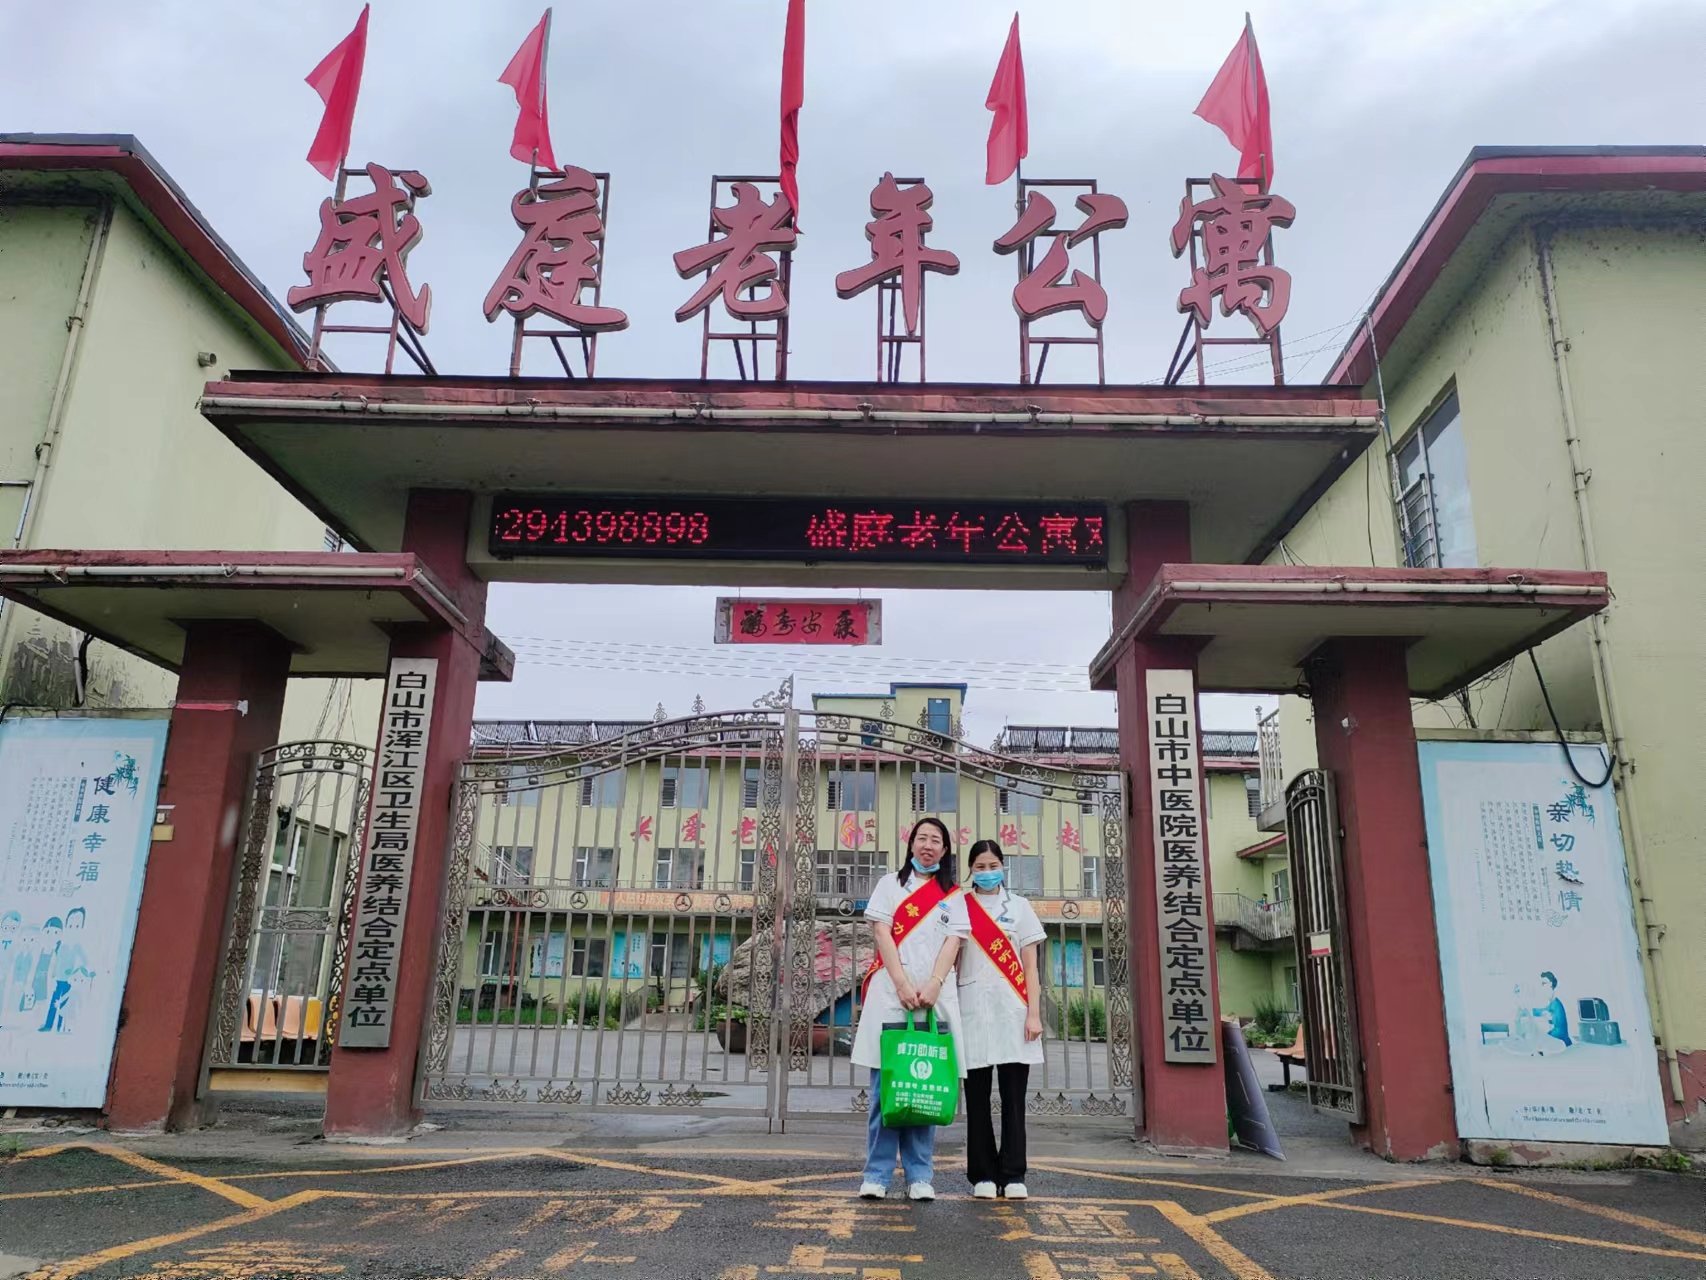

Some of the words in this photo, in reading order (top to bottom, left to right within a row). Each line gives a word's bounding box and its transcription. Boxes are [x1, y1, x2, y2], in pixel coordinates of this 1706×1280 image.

[287, 161, 1297, 337] 盛庭老年公寓
[76, 774, 116, 883] 健康幸福
[347, 671, 428, 1028] 白山市浑江区卫生局医养结合定点单位
[630, 811, 813, 846] 关爱老
[1154, 693, 1211, 1053] 白山市中医院医养结合定点单位
[1546, 801, 1584, 913] 亲切热情
